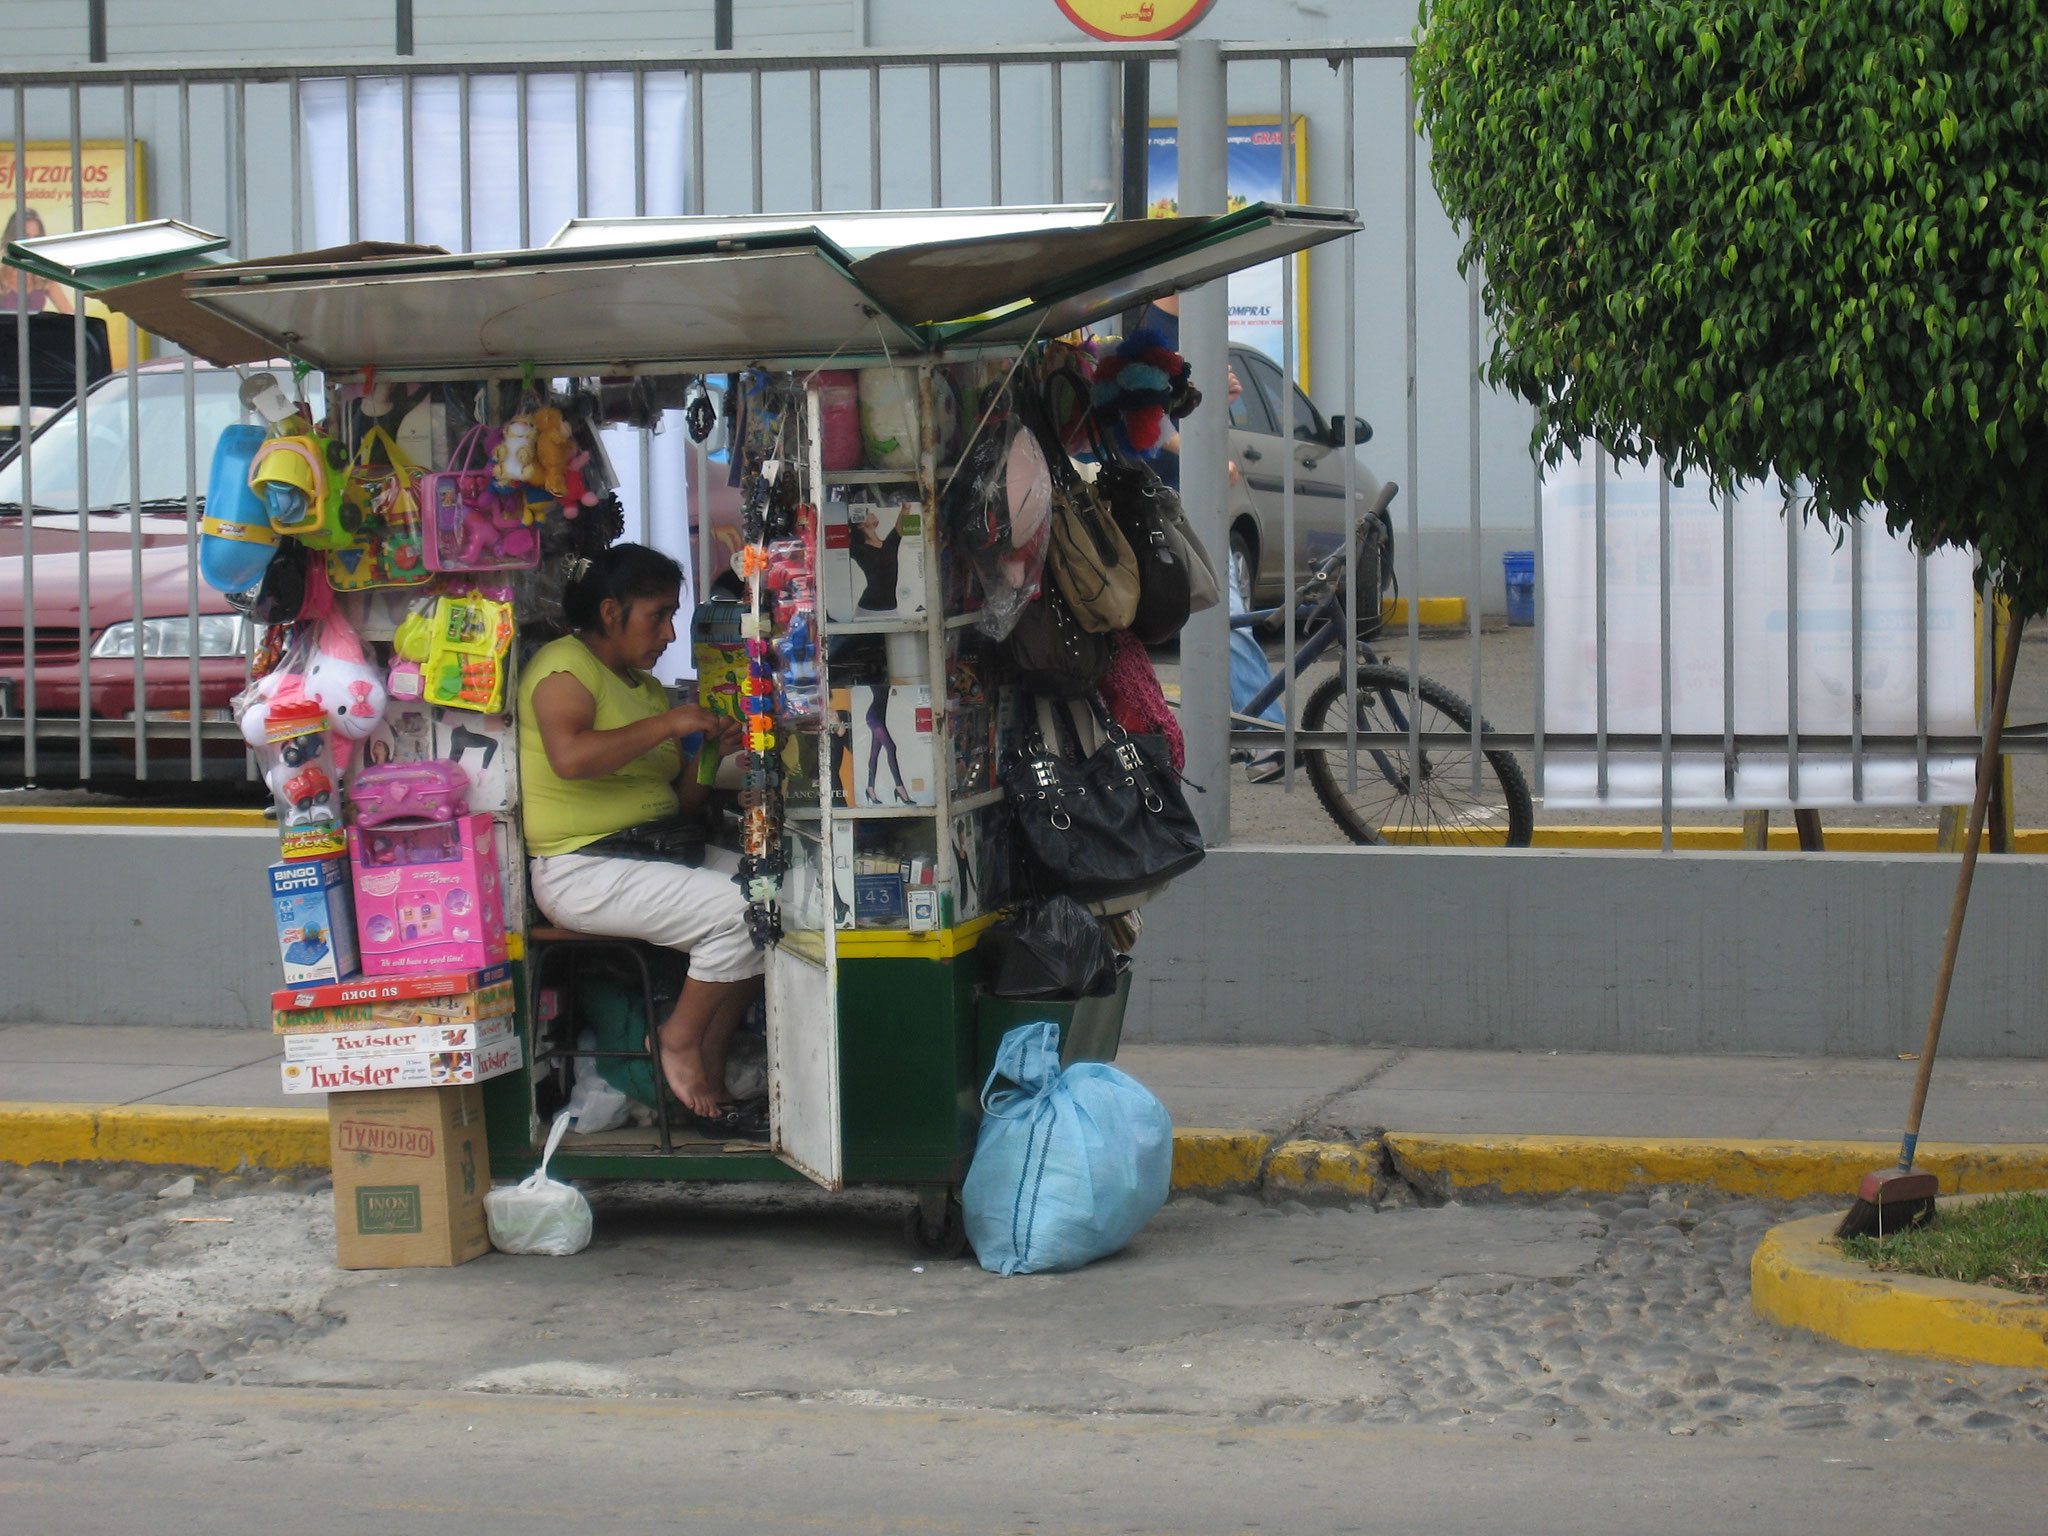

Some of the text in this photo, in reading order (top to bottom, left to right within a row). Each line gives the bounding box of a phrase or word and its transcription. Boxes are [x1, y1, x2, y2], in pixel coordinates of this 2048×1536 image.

[274, 866, 316, 881] BINGO
[275, 877, 318, 892] LOTTO
[341, 989, 377, 1001] DOKU
[382, 987, 398, 997] SU
[276, 1002, 372, 1027] Classic Wood
[332, 1034, 417, 1050] Twister
[477, 1050, 509, 1074] Twister
[306, 1064, 400, 1089] Twister
[343, 1126, 430, 1152] ORIGINAL
[368, 1196, 409, 1210] NONI
